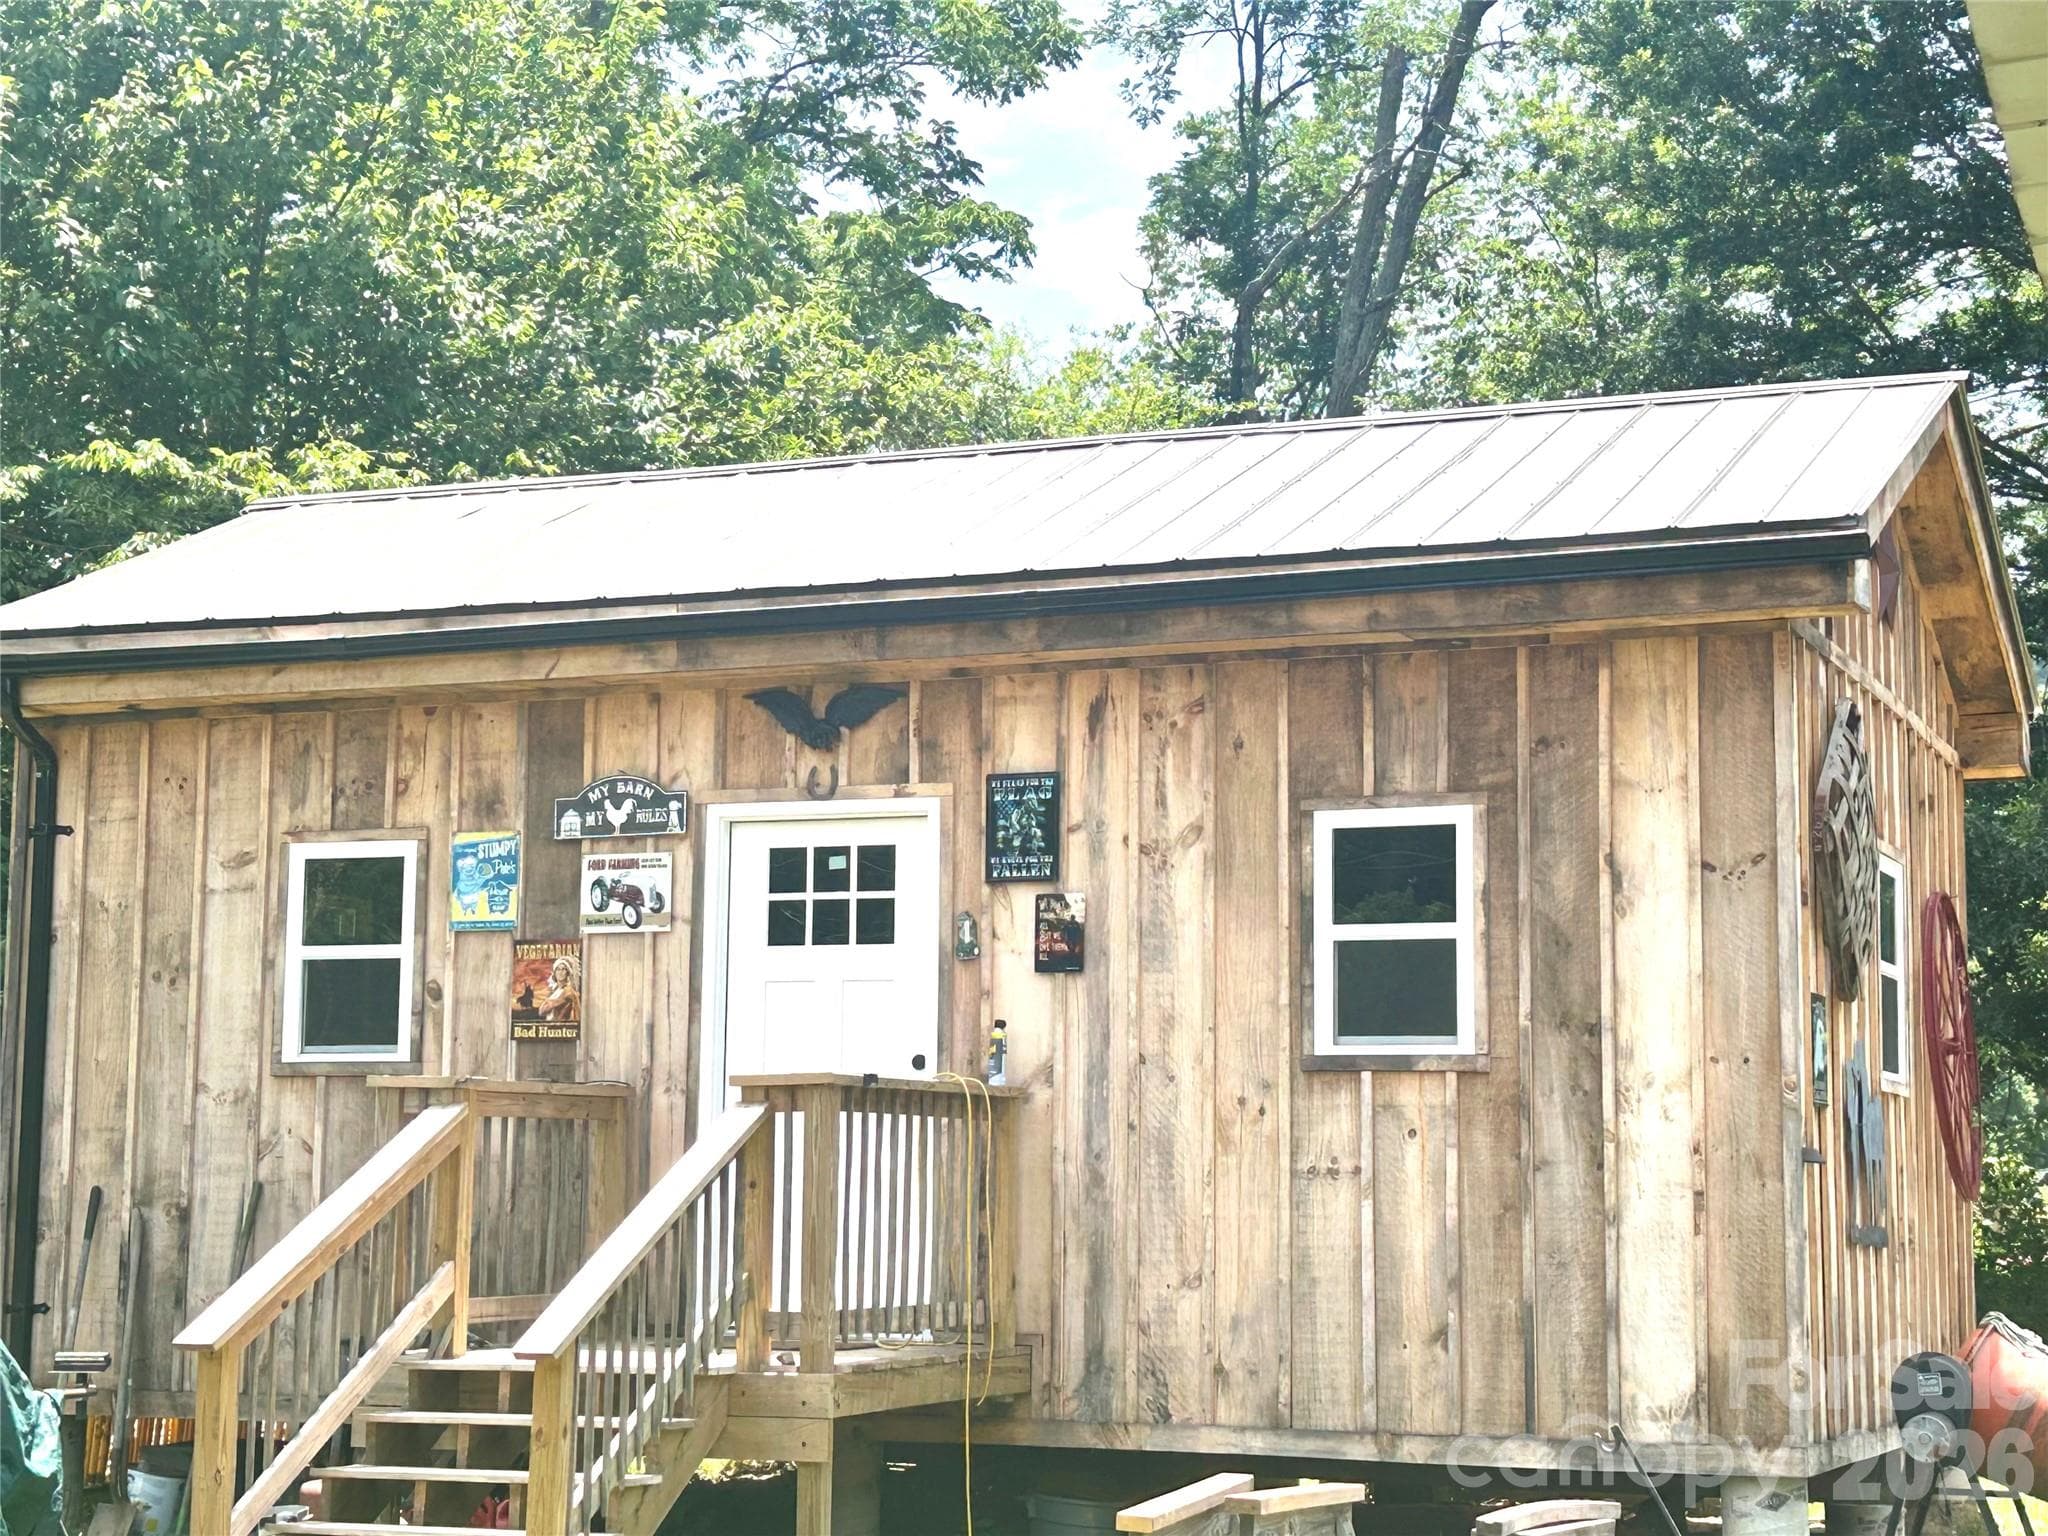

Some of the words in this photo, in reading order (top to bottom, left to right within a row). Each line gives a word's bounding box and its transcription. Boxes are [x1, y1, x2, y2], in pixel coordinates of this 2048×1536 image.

[586, 784, 610, 804] MY
[616, 781, 655, 801] BARN
[993, 786, 1053, 801] FLAG
[585, 810, 605, 827] MY
[635, 807, 669, 824] RULES
[478, 840, 517, 859] STUMPY
[587, 859, 606, 871] FORD
[608, 858, 640, 870] FARMING
[992, 863, 1051, 878] FALLEN
[516, 943, 580, 959] VEGETARIAN
[514, 1026, 536, 1038] Bad
[538, 1027, 577, 1038] Hunter
